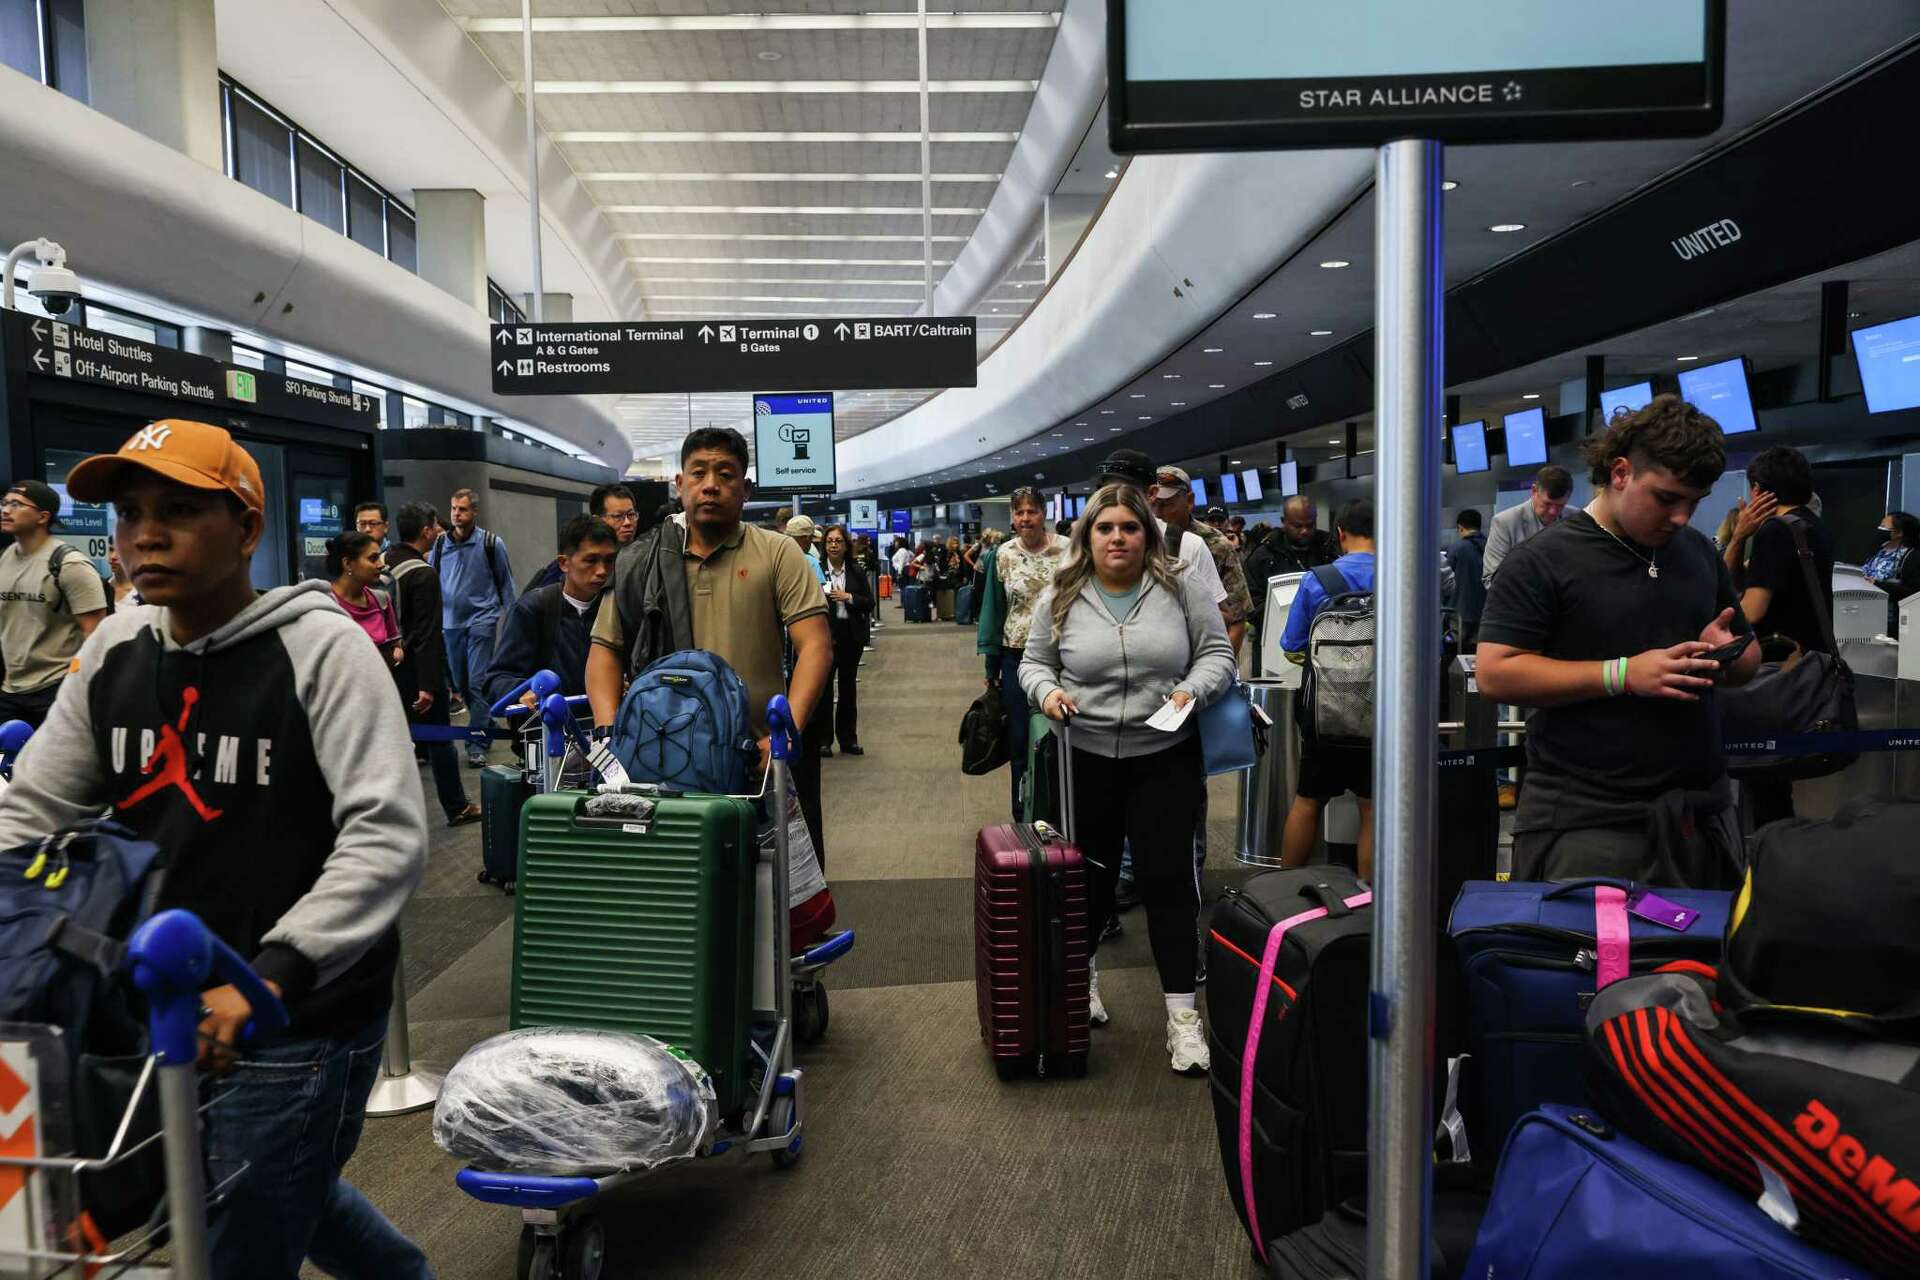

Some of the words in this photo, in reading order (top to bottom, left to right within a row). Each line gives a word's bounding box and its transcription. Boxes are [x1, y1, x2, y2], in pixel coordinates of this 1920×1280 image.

[1300, 90, 1361, 108] STAR
[1370, 84, 1492, 105] ALLIANCE
[1671, 218, 1742, 260] UNITED
[536, 329, 622, 343] International
[626, 328, 684, 341] Terminal
[740, 327, 799, 339] Terminal
[874, 323, 972, 337] BART/Caltrain
[73, 330, 104, 352] Hotel
[108, 339, 152, 363] Shuttles
[536, 347, 544, 355] A
[546, 346, 556, 355] &
[558, 346, 566, 355] G
[569, 346, 599, 355] Gates
[740, 343, 748, 352] B
[751, 343, 780, 352] Gates
[537, 361, 611, 373] Restrooms
[76, 360, 138, 385] Off-Airport
[141, 372, 178, 396] Parking
[181, 380, 215, 399] Shuttle
[285, 380, 300, 395] SFO
[302, 384, 327, 403] Parking
[328, 390, 351, 406] Shuttle
[776, 467, 789, 475] Self
[89, 538, 107, 557] 09
